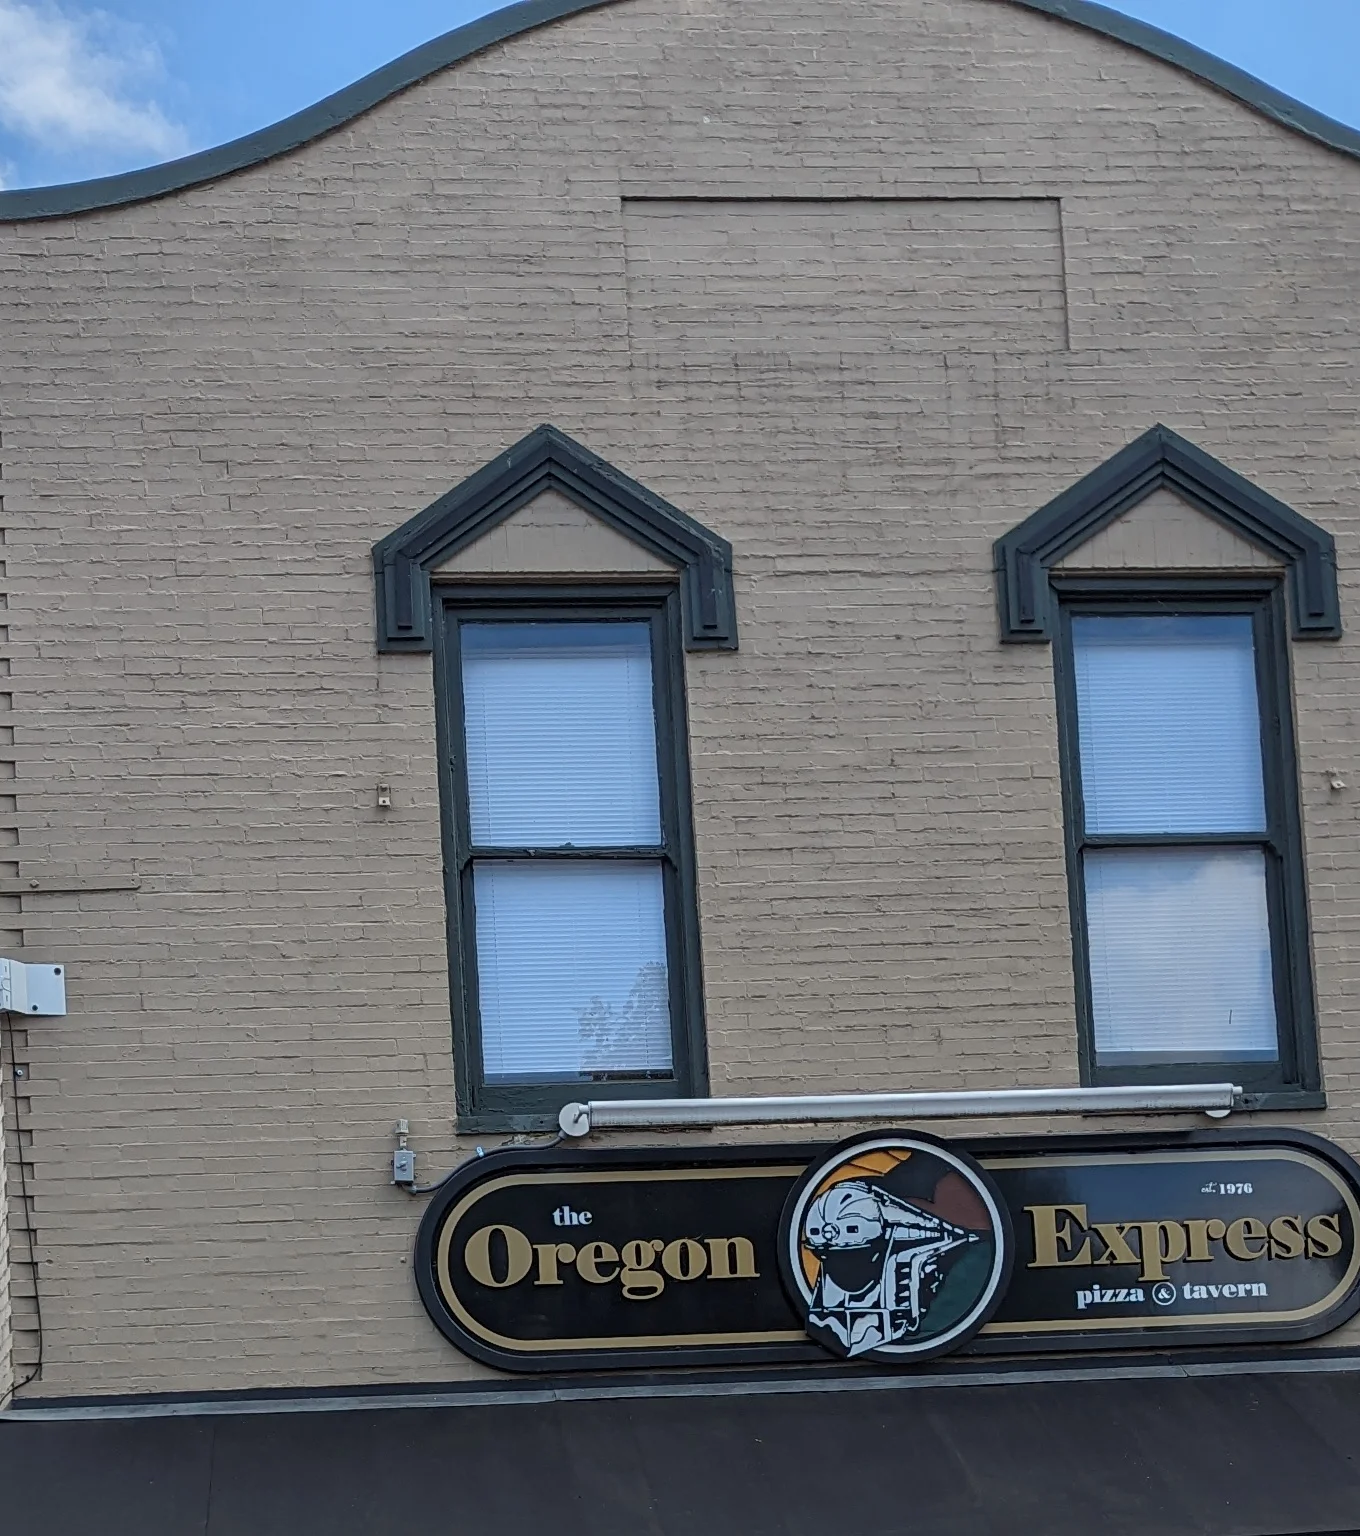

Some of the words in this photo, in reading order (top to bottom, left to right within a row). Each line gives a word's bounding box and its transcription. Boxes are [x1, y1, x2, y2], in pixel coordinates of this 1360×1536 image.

[1219, 1182, 1254, 1196] 1976
[552, 1205, 593, 1227] the
[1023, 1202, 1344, 1284] Express
[463, 1223, 760, 1301] Oregon
[1076, 1283, 1146, 1311] pizza
[1154, 1283, 1174, 1304] &
[1181, 1281, 1268, 1304] tavern
